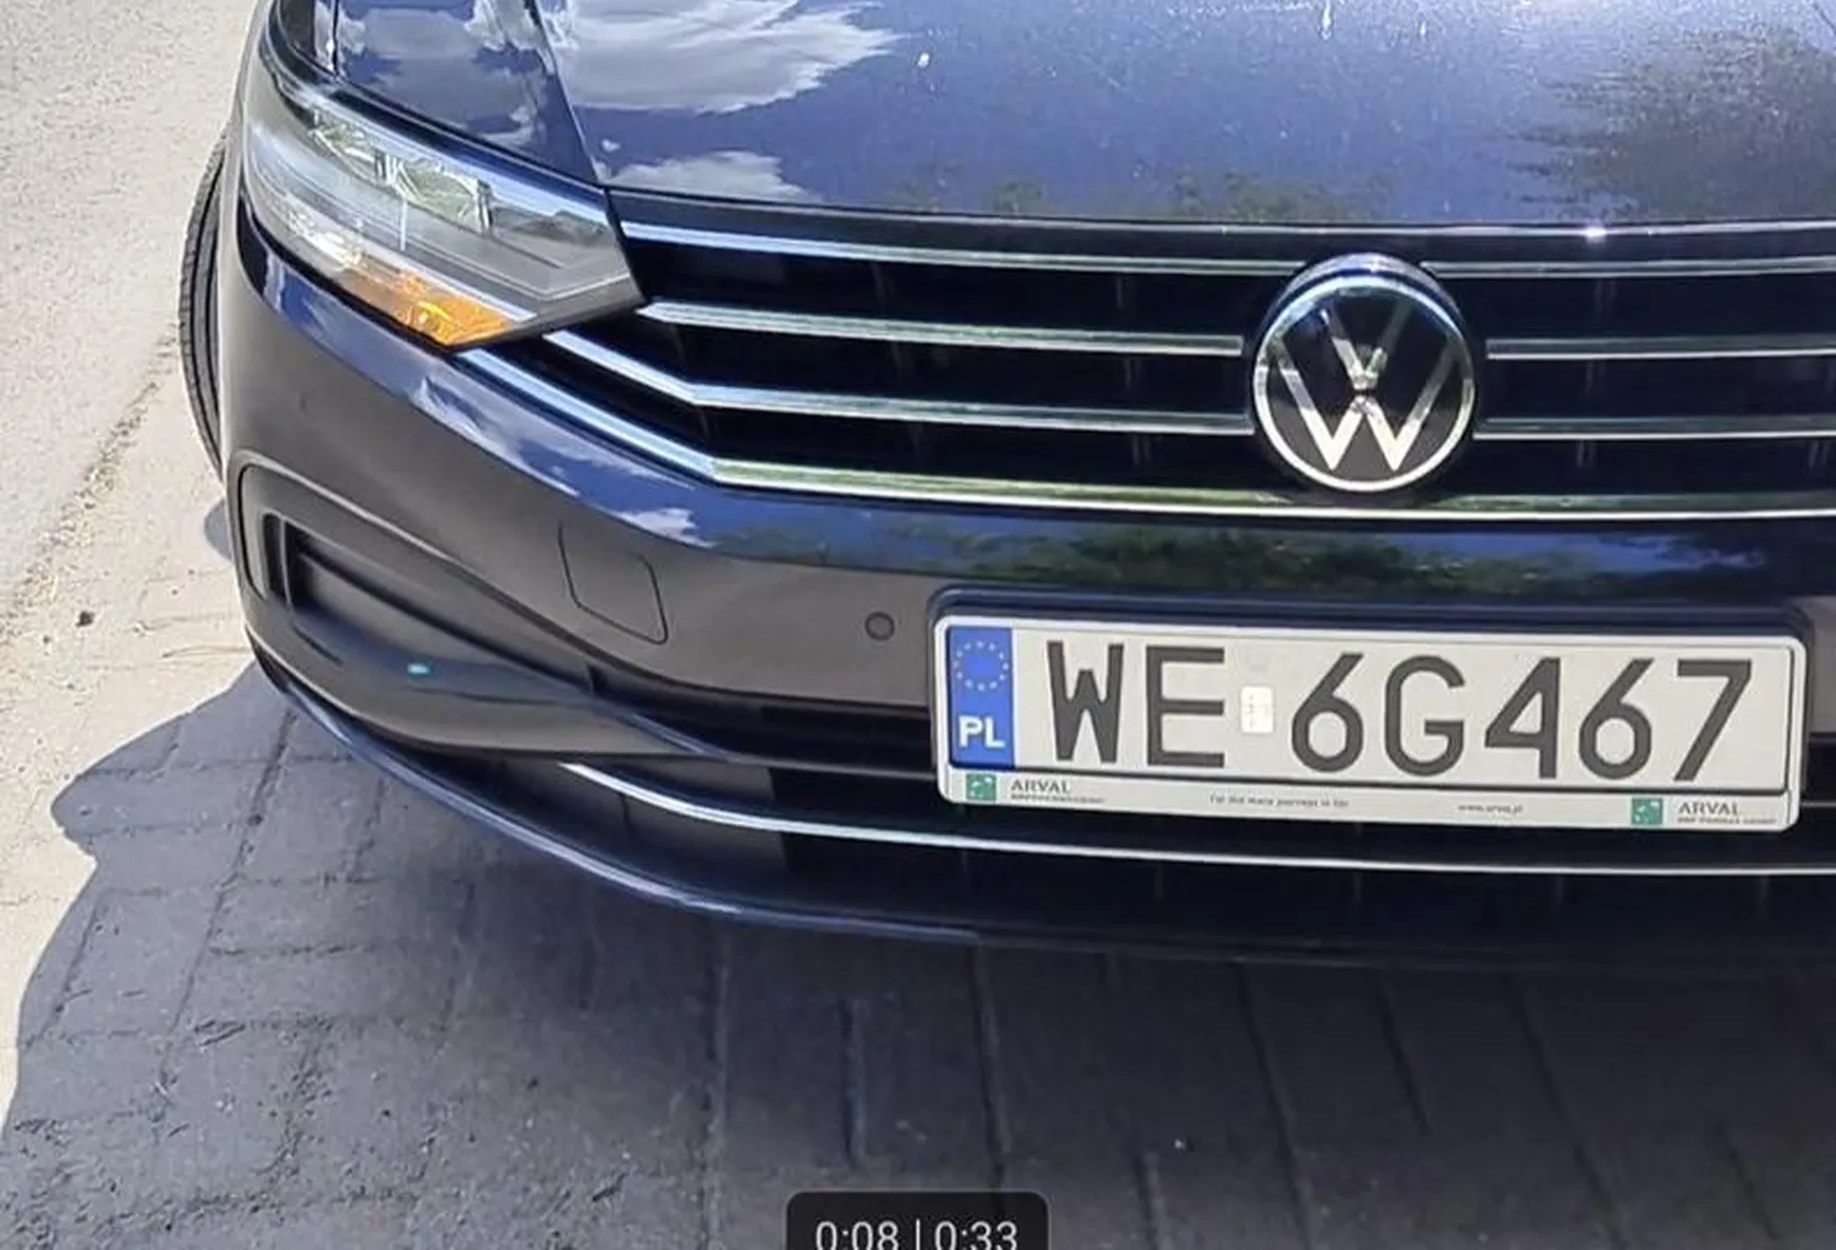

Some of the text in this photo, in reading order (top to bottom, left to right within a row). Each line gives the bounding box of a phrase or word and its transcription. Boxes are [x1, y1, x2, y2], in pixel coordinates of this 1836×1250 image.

[1047, 640, 1752, 782] WE 6G467
[959, 715, 1006, 749] PL
[1011, 779, 1070, 793] ARVAL
[1679, 802, 1739, 816] ARVAL
